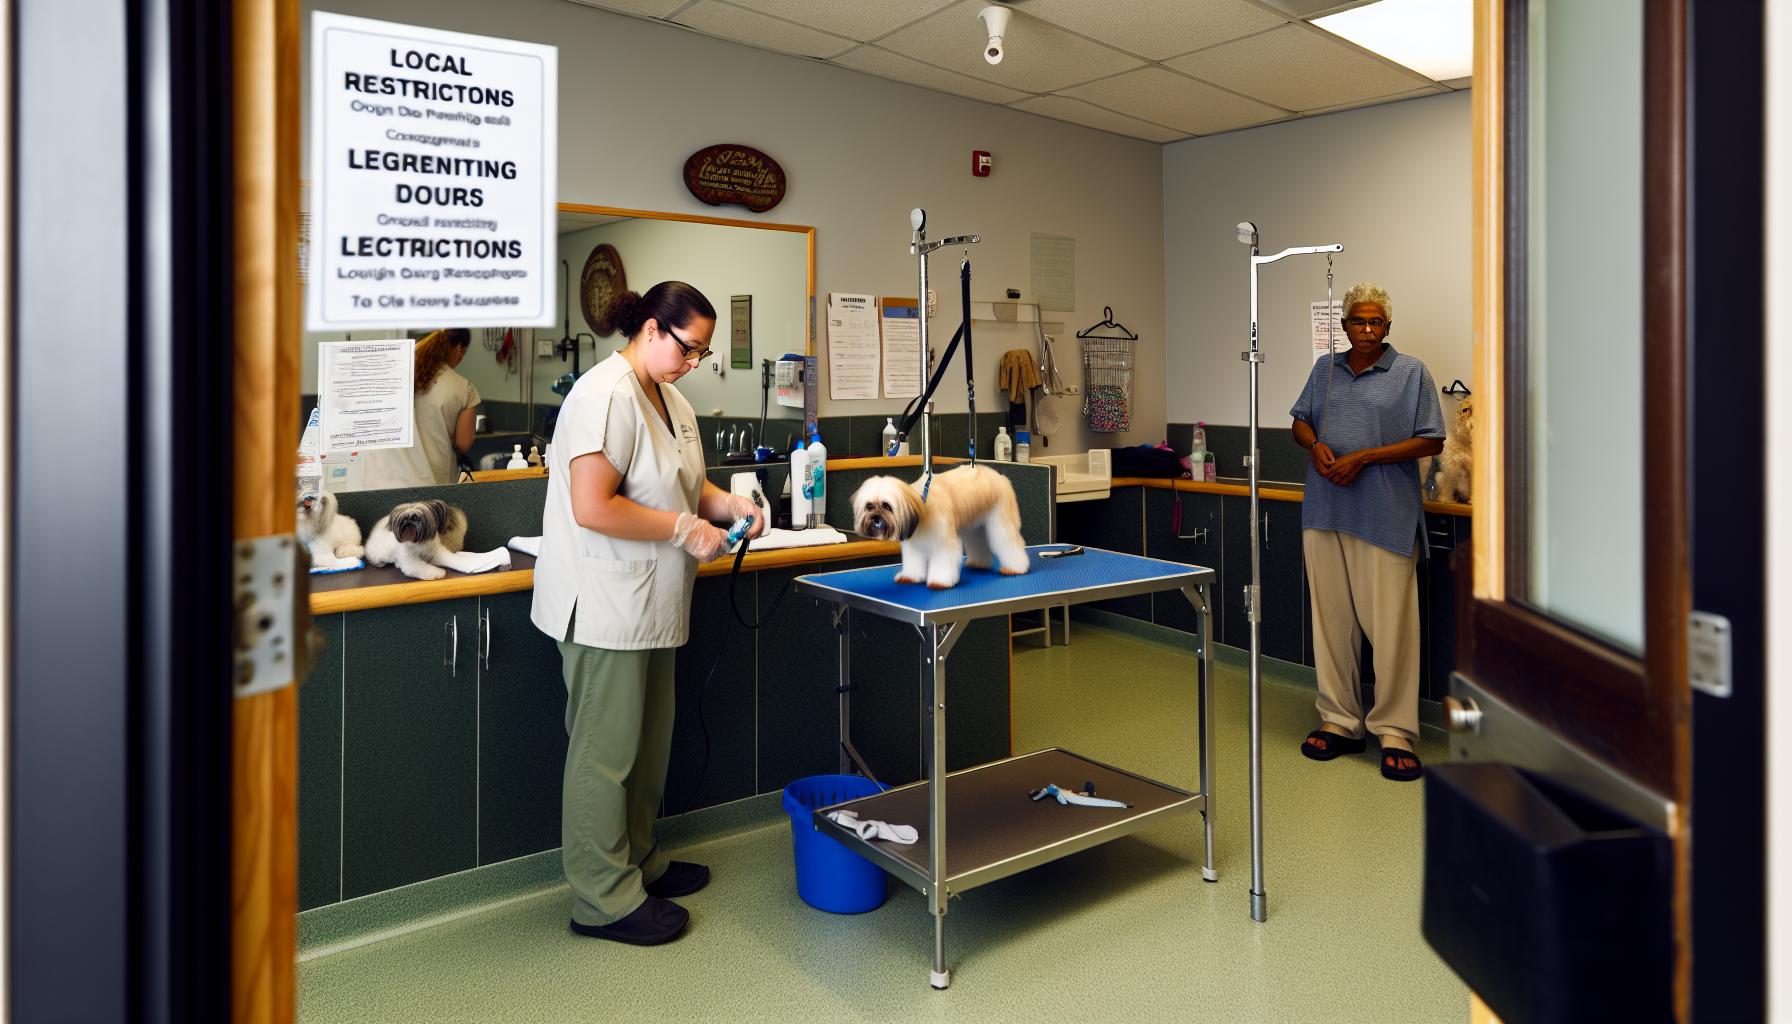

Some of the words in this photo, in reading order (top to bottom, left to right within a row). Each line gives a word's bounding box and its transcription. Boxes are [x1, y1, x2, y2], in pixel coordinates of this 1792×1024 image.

[390, 48, 473, 77] LOCAL
[344, 71, 515, 108] RESTRICTONS
[348, 148, 517, 180] LEGRENITING
[396, 184, 484, 207] DOURS
[341, 236, 522, 259] LECTRICTIONS
